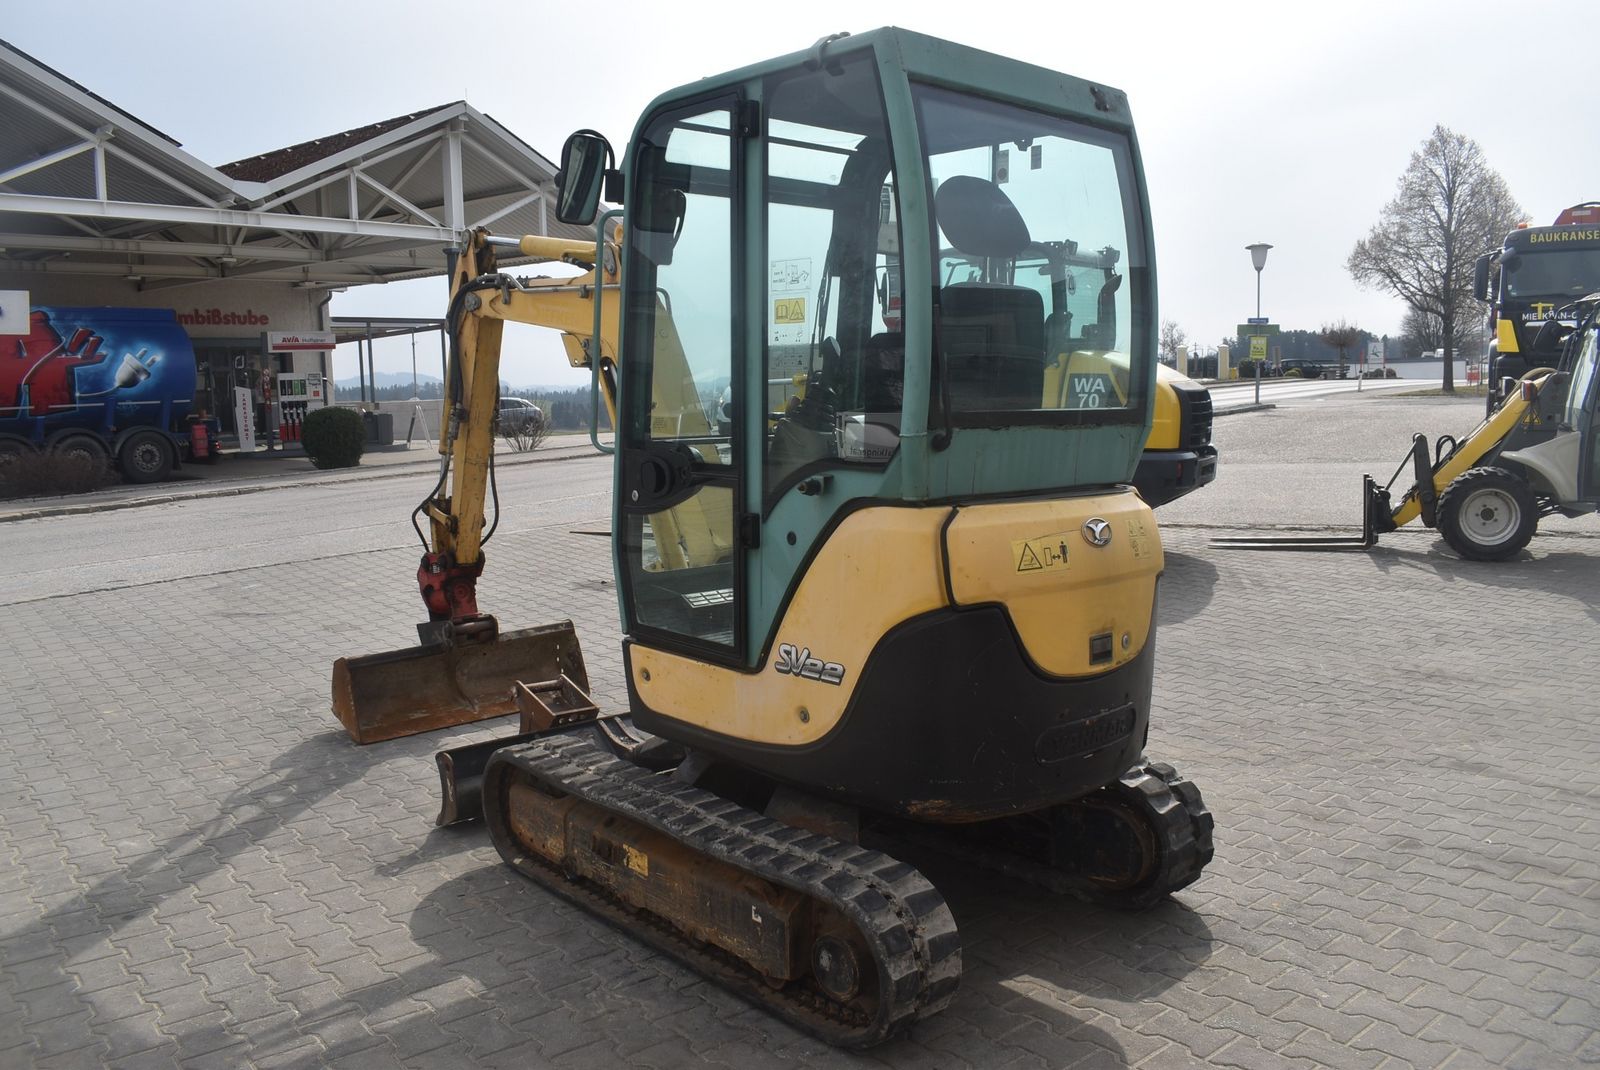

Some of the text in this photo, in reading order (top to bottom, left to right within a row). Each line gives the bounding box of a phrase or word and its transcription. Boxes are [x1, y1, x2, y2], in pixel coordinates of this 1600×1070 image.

[177, 308, 269, 325] mbißstube
[281, 335, 300, 343] AVIA
[1074, 377, 1106, 393] WA
[1078, 393, 1100, 408] 70
[774, 643, 846, 686] SV22
